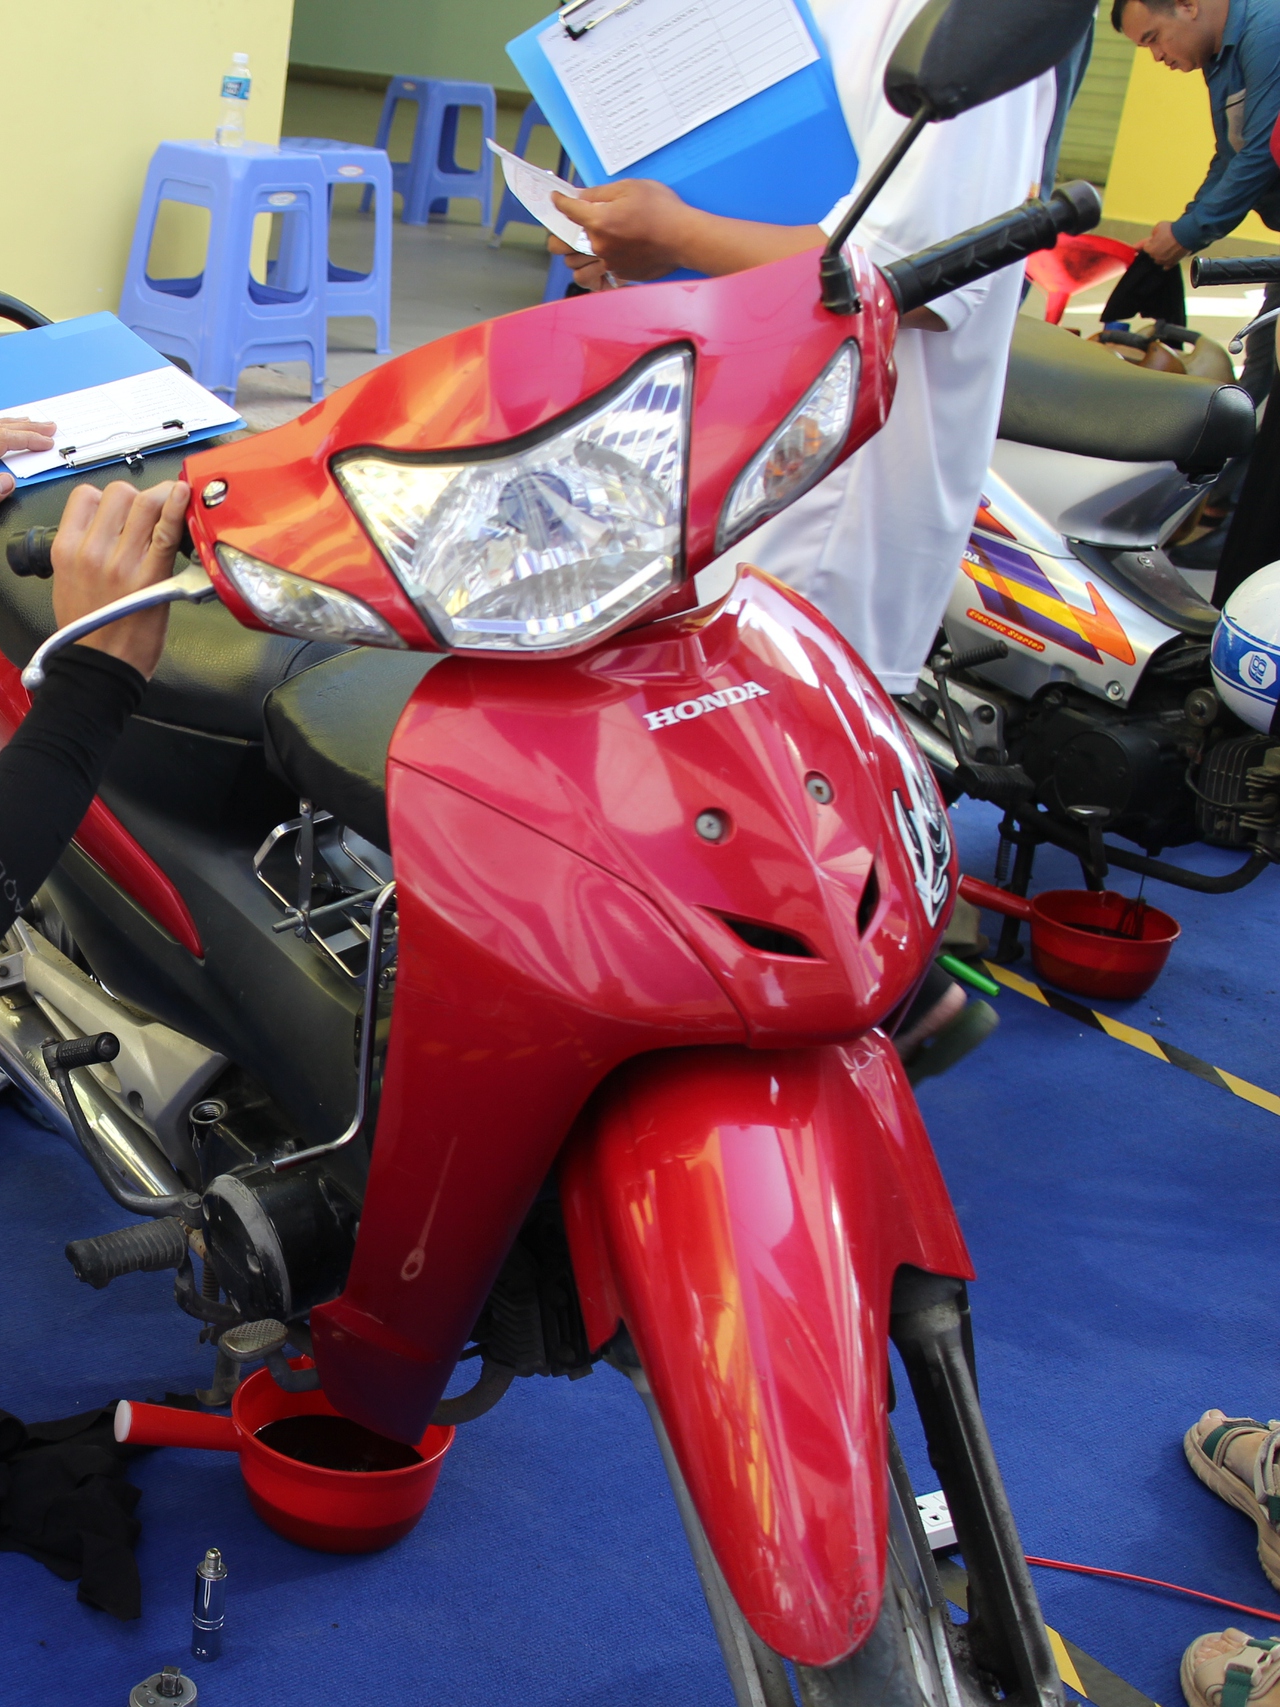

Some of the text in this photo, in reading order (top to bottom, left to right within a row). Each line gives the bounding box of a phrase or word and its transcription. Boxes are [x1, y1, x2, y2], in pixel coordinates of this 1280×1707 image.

[969, 610, 1044, 650] Electric Starter
[642, 680, 770, 731] HONDA
